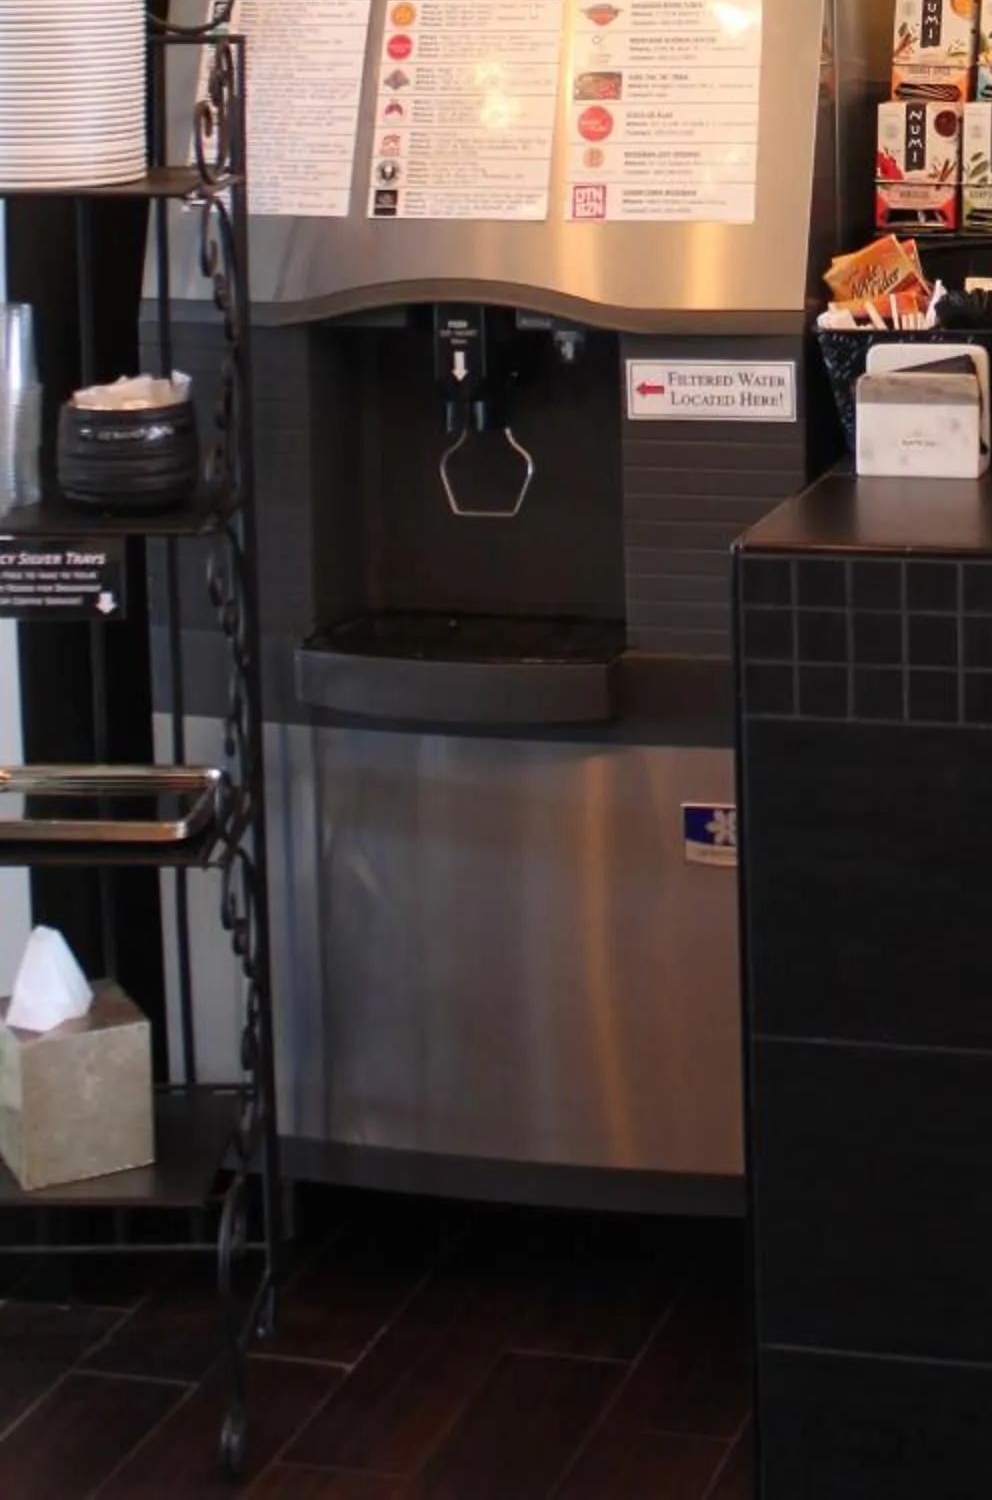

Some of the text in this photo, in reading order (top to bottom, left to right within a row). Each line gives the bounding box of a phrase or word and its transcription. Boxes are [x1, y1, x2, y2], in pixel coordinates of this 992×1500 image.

[907, 109, 925, 163] NUMI
[667, 371, 786, 388] FILTERED WATER
[670, 391, 784, 408] LOCATED HERE!
